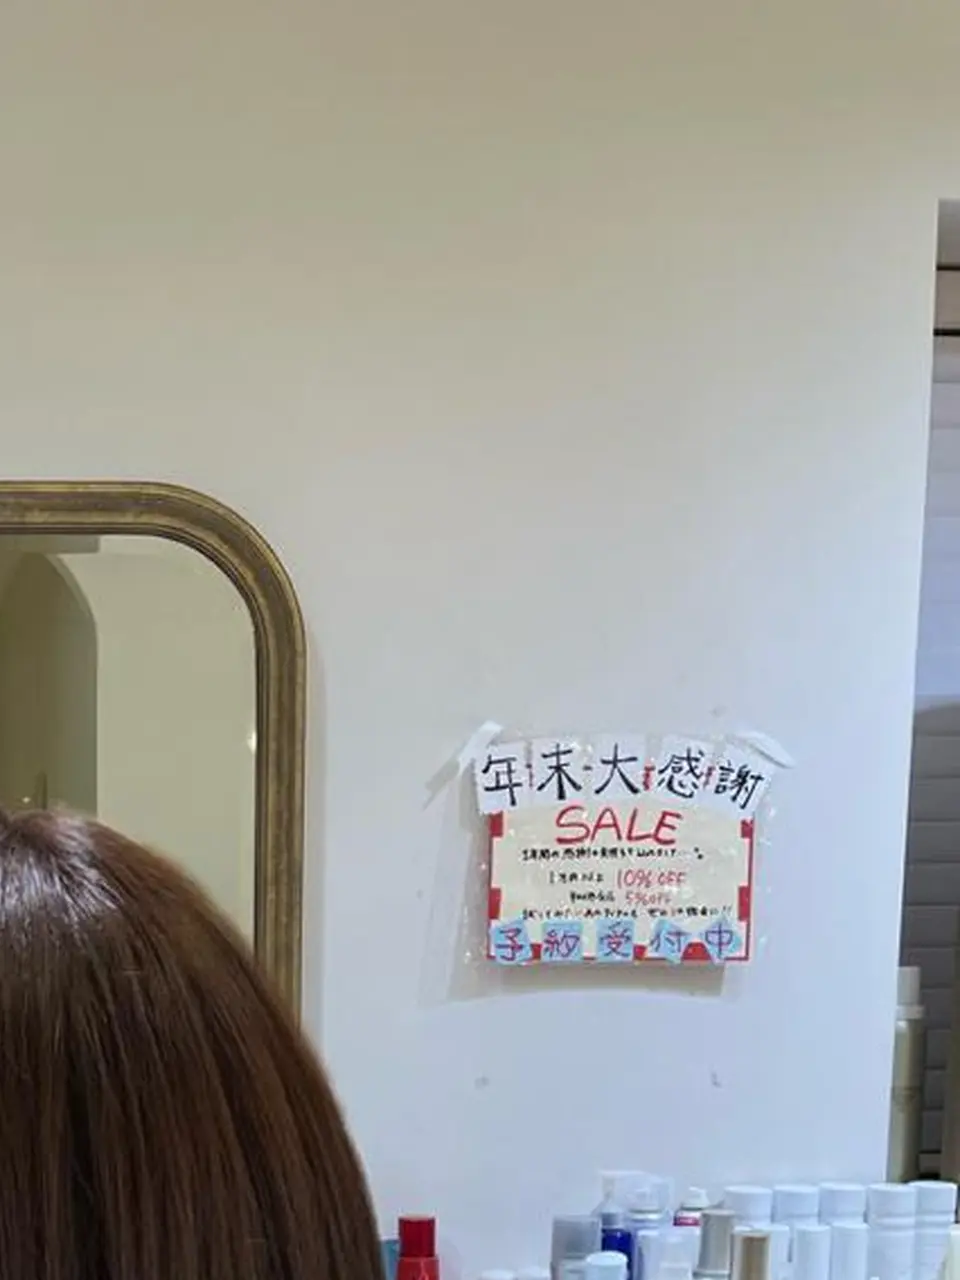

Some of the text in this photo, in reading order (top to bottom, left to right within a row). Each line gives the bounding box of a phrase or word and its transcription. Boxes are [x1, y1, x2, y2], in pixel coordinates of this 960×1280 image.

[482, 743, 764, 809] 年末大感謝
[555, 804, 683, 845] SALE
